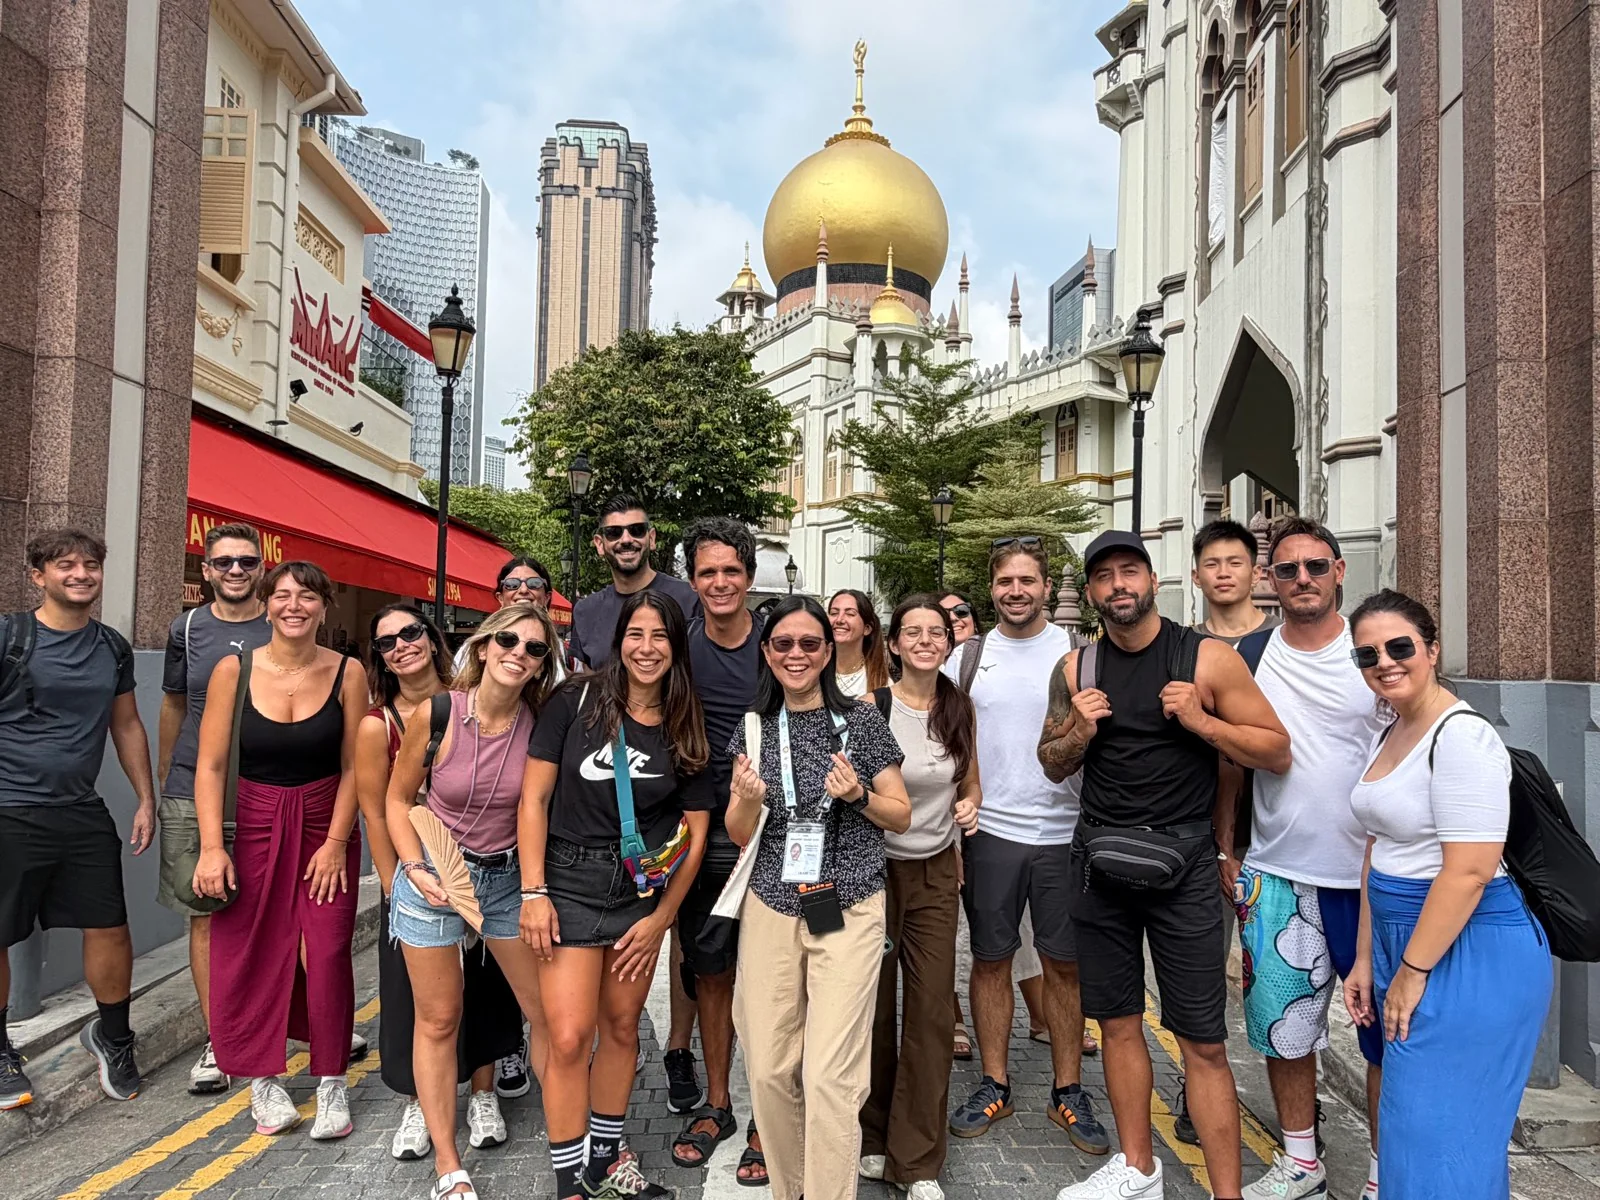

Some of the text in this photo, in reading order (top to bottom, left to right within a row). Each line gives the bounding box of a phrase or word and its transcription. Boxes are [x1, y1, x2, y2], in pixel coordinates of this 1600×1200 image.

[290, 267, 364, 384] MINANG
[185, 513, 215, 547] AN
[183, 585, 201, 601] RINK
[595, 741, 652, 773] NKE
